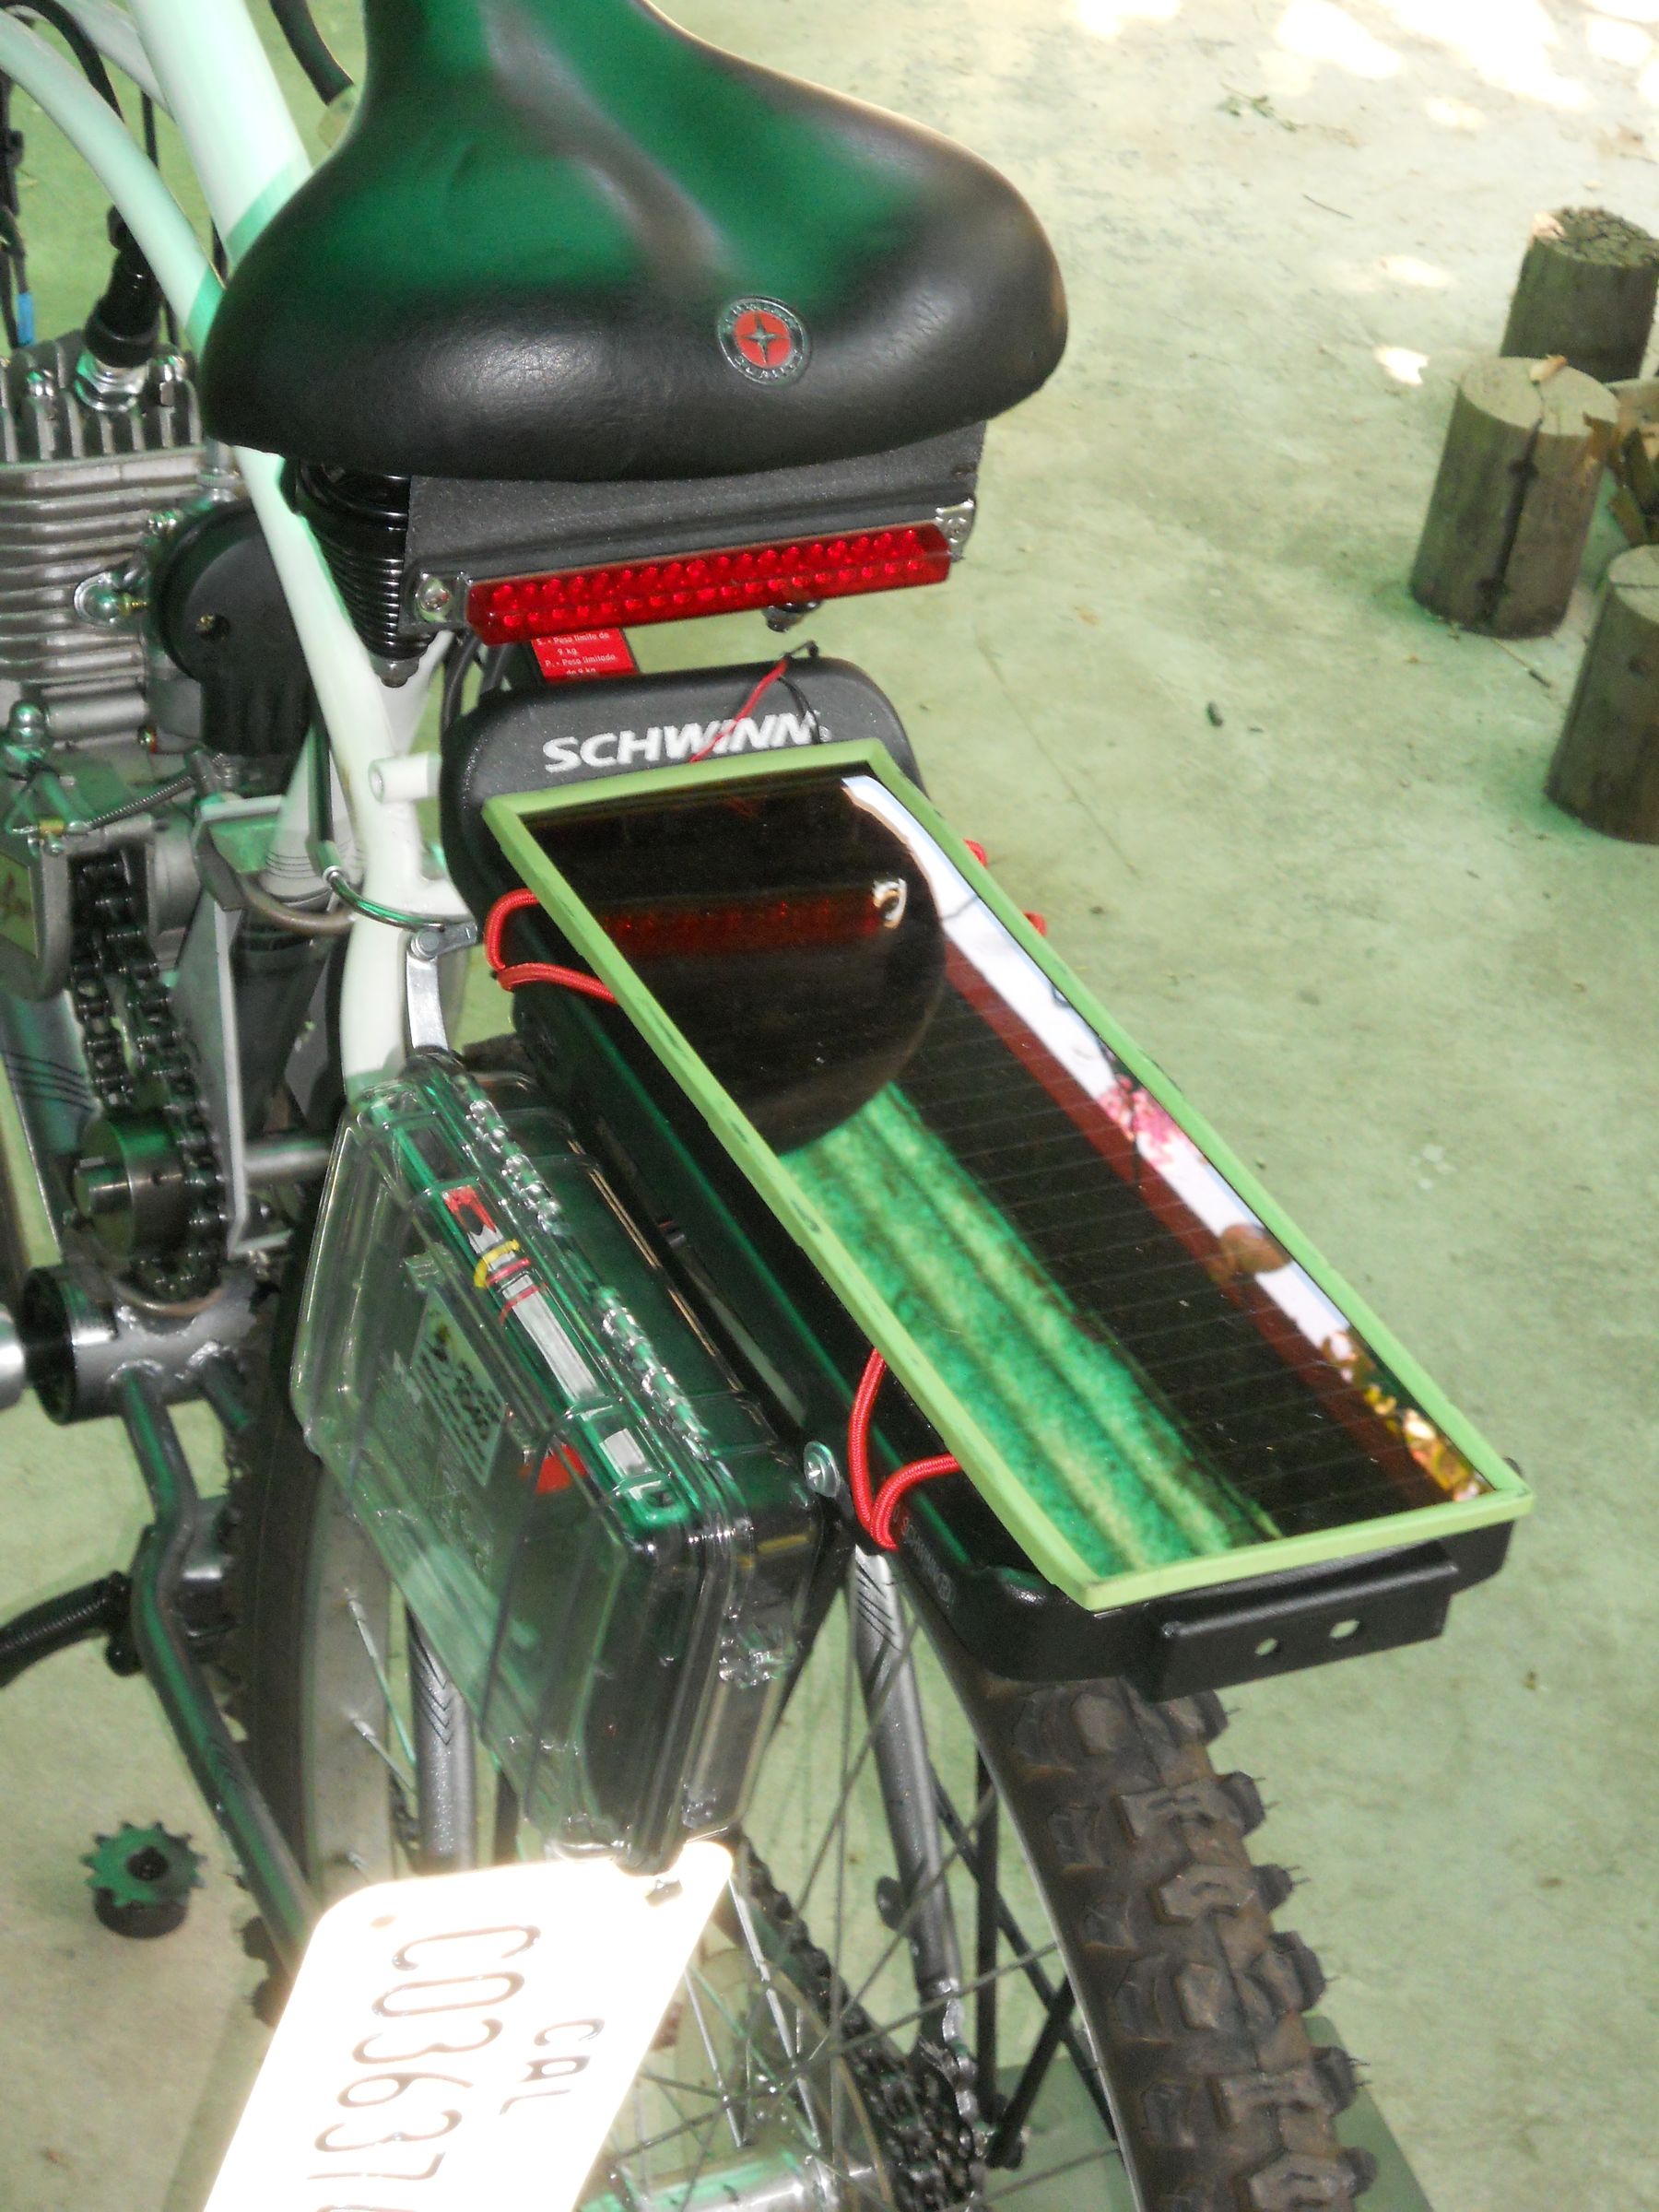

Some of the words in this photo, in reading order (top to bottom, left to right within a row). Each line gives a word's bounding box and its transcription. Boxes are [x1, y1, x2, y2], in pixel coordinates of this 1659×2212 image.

[553, 636, 572, 644] Peso
[566, 648, 577, 656] kg
[542, 710, 821, 772] SCHWINN
[306, 1924, 542, 2212] C03637
[499, 2018, 605, 2115] CAL
